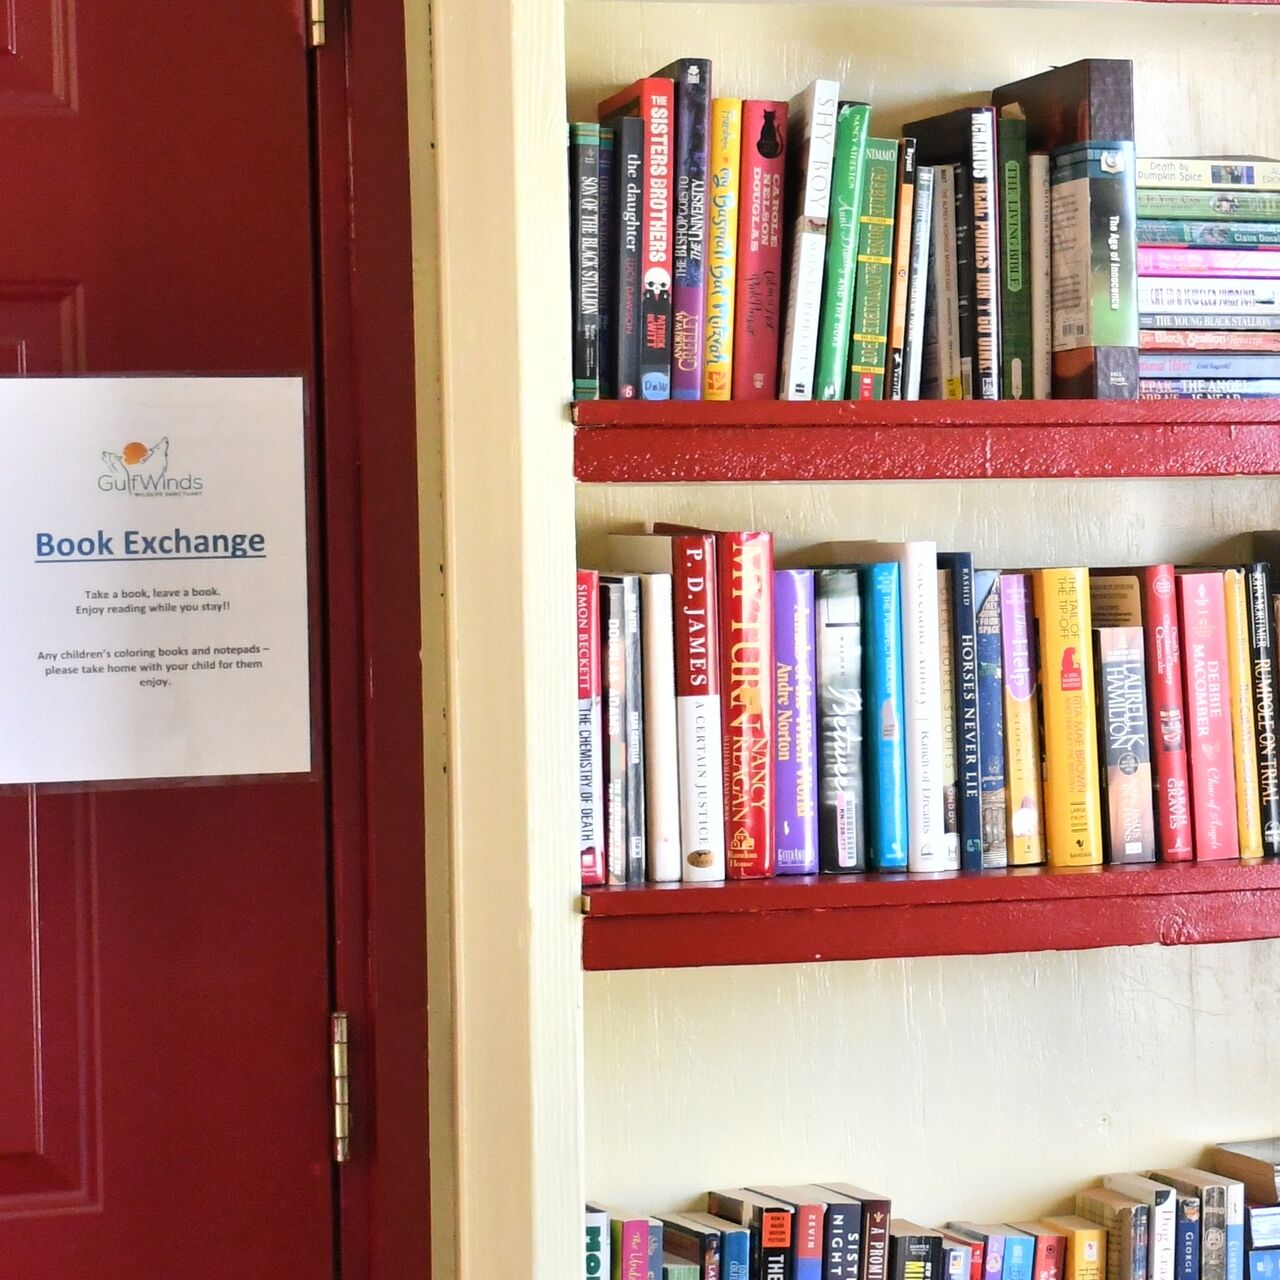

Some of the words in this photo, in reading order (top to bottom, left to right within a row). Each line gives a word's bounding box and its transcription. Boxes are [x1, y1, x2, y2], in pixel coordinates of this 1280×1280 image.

[651, 96, 667, 104] THE
[817, 97, 832, 144] SHY
[650, 108, 667, 175] SISTERS
[866, 150, 895, 160] NIMMO
[581, 176, 599, 195] SON
[627, 154, 638, 177] the
[809, 161, 829, 209] BOY
[1007, 167, 1017, 196] THE
[581, 198, 599, 212] OF
[581, 214, 599, 234] THE
[624, 184, 639, 252] daughter
[649, 178, 667, 262] BROTHERS
[687, 179, 703, 240] UNIVERSITY
[751, 167, 761, 252] DOUGLAS
[761, 173, 771, 245] NELSON
[770, 174, 780, 248] CAROLE
[1008, 201, 1018, 245] LIVING
[1109, 216, 1120, 231] The
[581, 238, 599, 269] BLACK
[1108, 234, 1120, 250] Age
[1110, 252, 1120, 261] of
[1009, 248, 1019, 287] BIBLE
[1110, 264, 1120, 310] Innocence
[581, 271, 599, 315] STALLION
[98, 474, 203, 495] GulfWinds
[37, 530, 114, 556] Book
[124, 528, 265, 558] Exchange
[687, 549, 702, 567] P.
[76, 605, 104, 616] Enjoy
[107, 602, 146, 615] reading
[149, 602, 176, 613] while
[180, 604, 198, 614] you
[202, 601, 230, 613] stay!!
[86, 589, 109, 600] Take
[121, 588, 150, 601] book,
[153, 588, 180, 598] leave
[192, 587, 221, 597] book.
[688, 577, 703, 599] D.
[38, 651, 57, 662] Any
[114, 648, 155, 660] coloring
[158, 647, 189, 657] books
[192, 646, 210, 656] and
[213, 645, 260, 657] notepads
[45, 665, 78, 677] please
[82, 664, 103, 675] take
[107, 663, 136, 673] home
[140, 662, 162, 672] with
[165, 662, 187, 674] your
[191, 660, 215, 671] child
[218, 659, 232, 670] for
[236, 659, 262, 669] them
[684, 607, 707, 686] JAMES
[962, 635, 975, 700] HORSES
[140, 679, 171, 689] enjoy.
[696, 701, 706, 709] A
[777, 663, 792, 706] Andre
[1125, 663, 1142, 728] LAURELL
[1193, 644, 1209, 736] MACOMBER
[1208, 660, 1221, 717] DEBBIE
[1255, 659, 1274, 728] RUMPOLE
[1107, 667, 1127, 749] HAMILTON
[695, 716, 707, 778] CERTAIN
[778, 710, 793, 760] Norton
[964, 708, 976, 768] NEVER
[1129, 732, 1144, 750] K.
[1260, 732, 1275, 754] ON
[731, 736, 749, 822] REAGAN
[750, 736, 768, 810] NANCY
[966, 772, 978, 798] LIE
[1262, 759, 1279, 805] TRIAL
[696, 784, 709, 844] JUSTICE
[807, 1214, 815, 1248] ZEVIN
